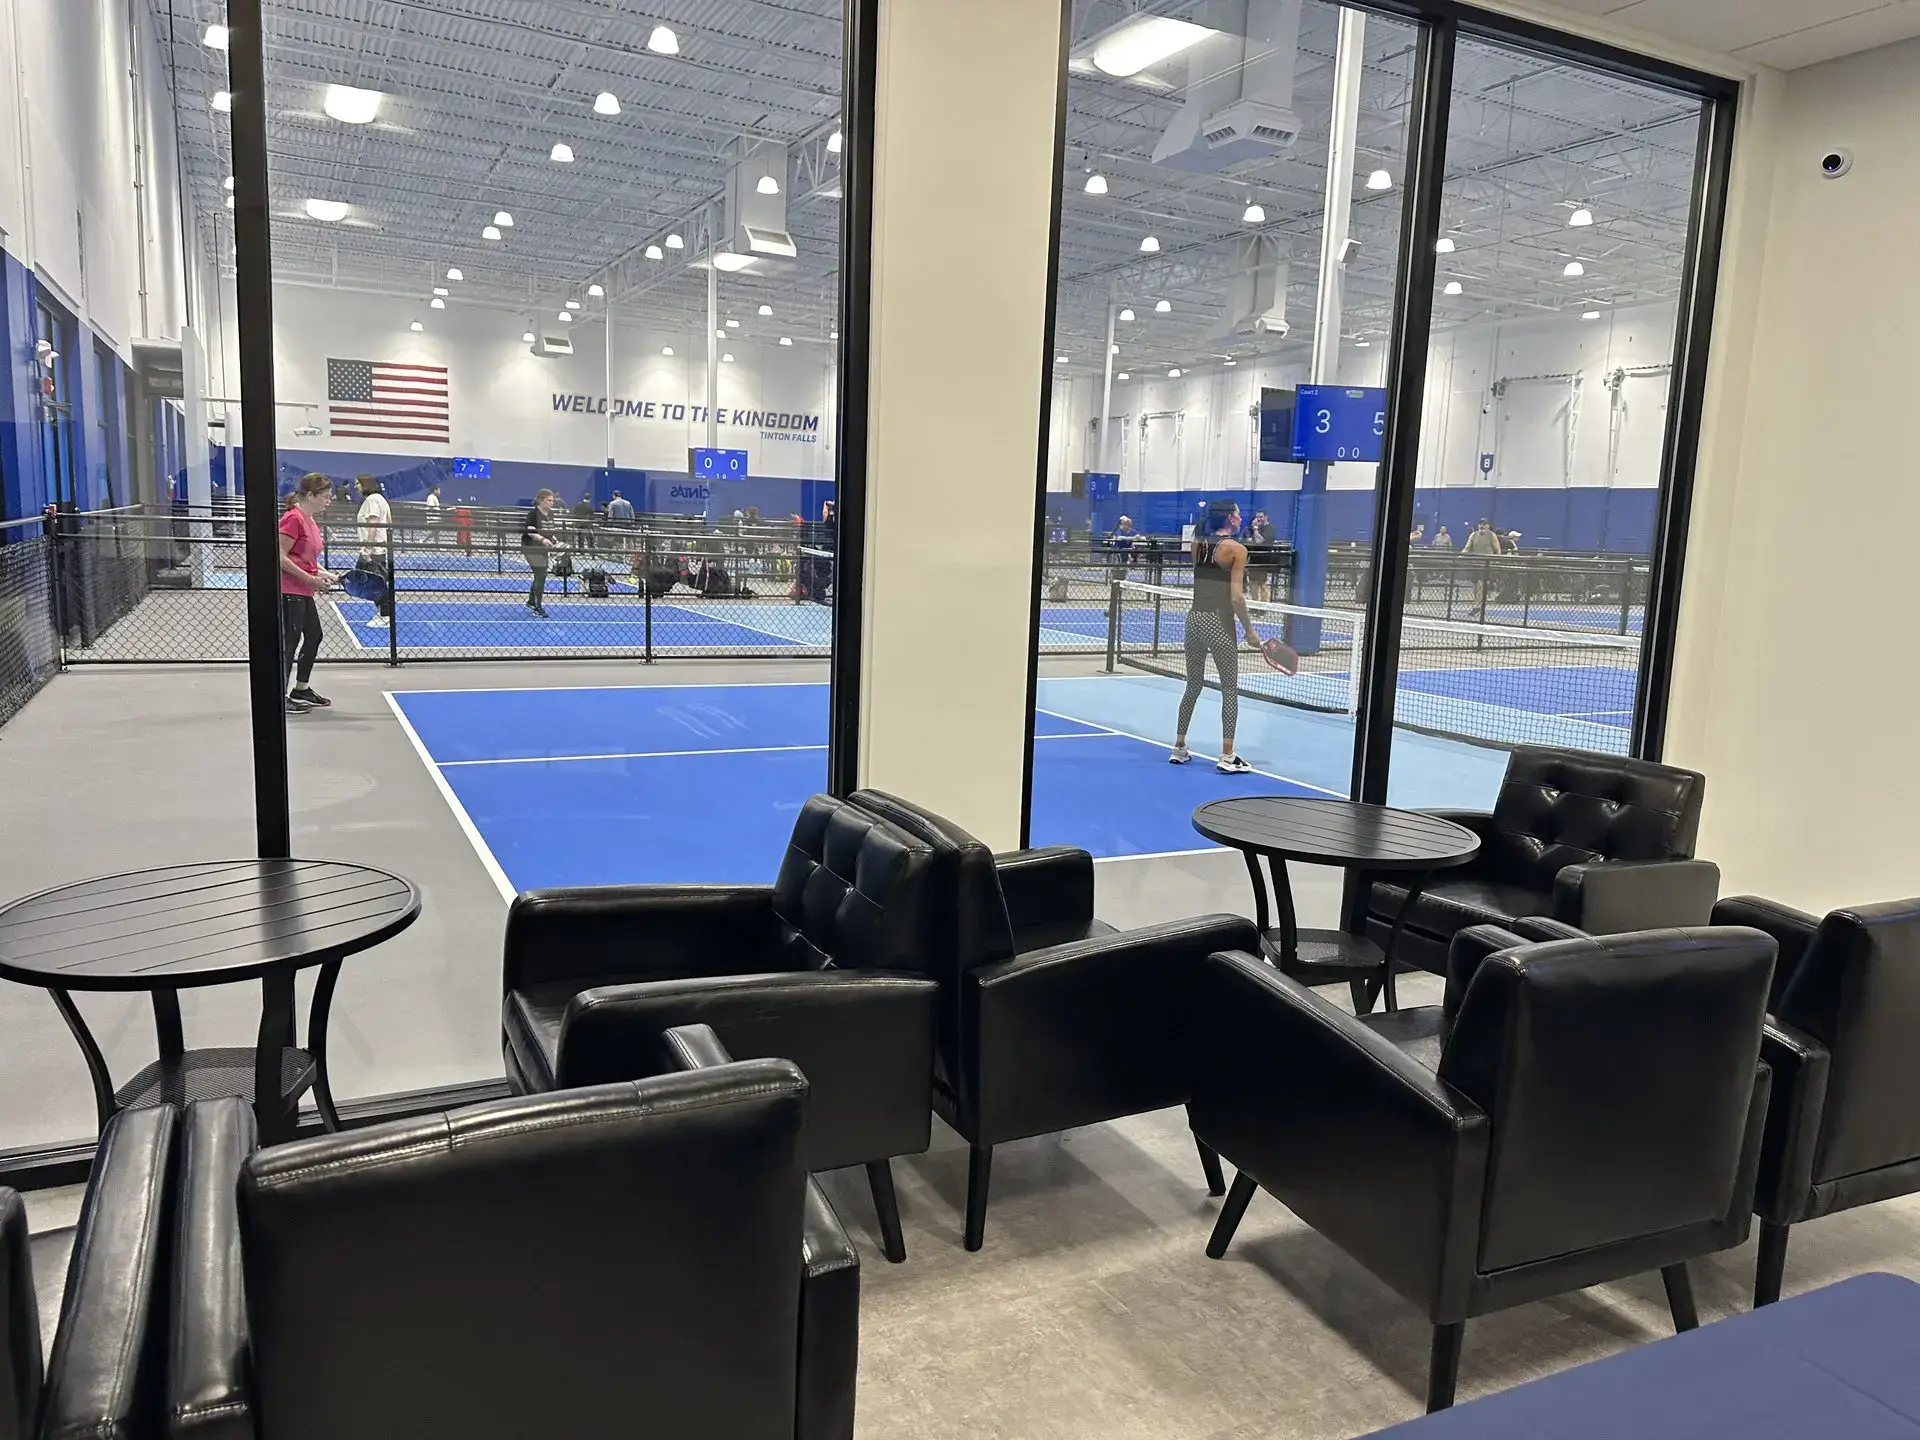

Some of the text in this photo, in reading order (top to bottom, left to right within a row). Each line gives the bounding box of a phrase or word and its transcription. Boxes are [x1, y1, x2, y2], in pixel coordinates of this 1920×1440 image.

[552, 394, 656, 418] WELCOME
[661, 403, 685, 420] TO
[732, 409, 819, 431] KINGDOM
[1315, 409, 1385, 435] 3 5
[760, 432, 817, 443] TINTON FALLS
[1337, 446, 1360, 458] 0 0
[461, 463, 485, 472] 7 7
[704, 457, 738, 470] 0 0
[1484, 459, 1490, 468] 8
[1091, 481, 1097, 491] 3
